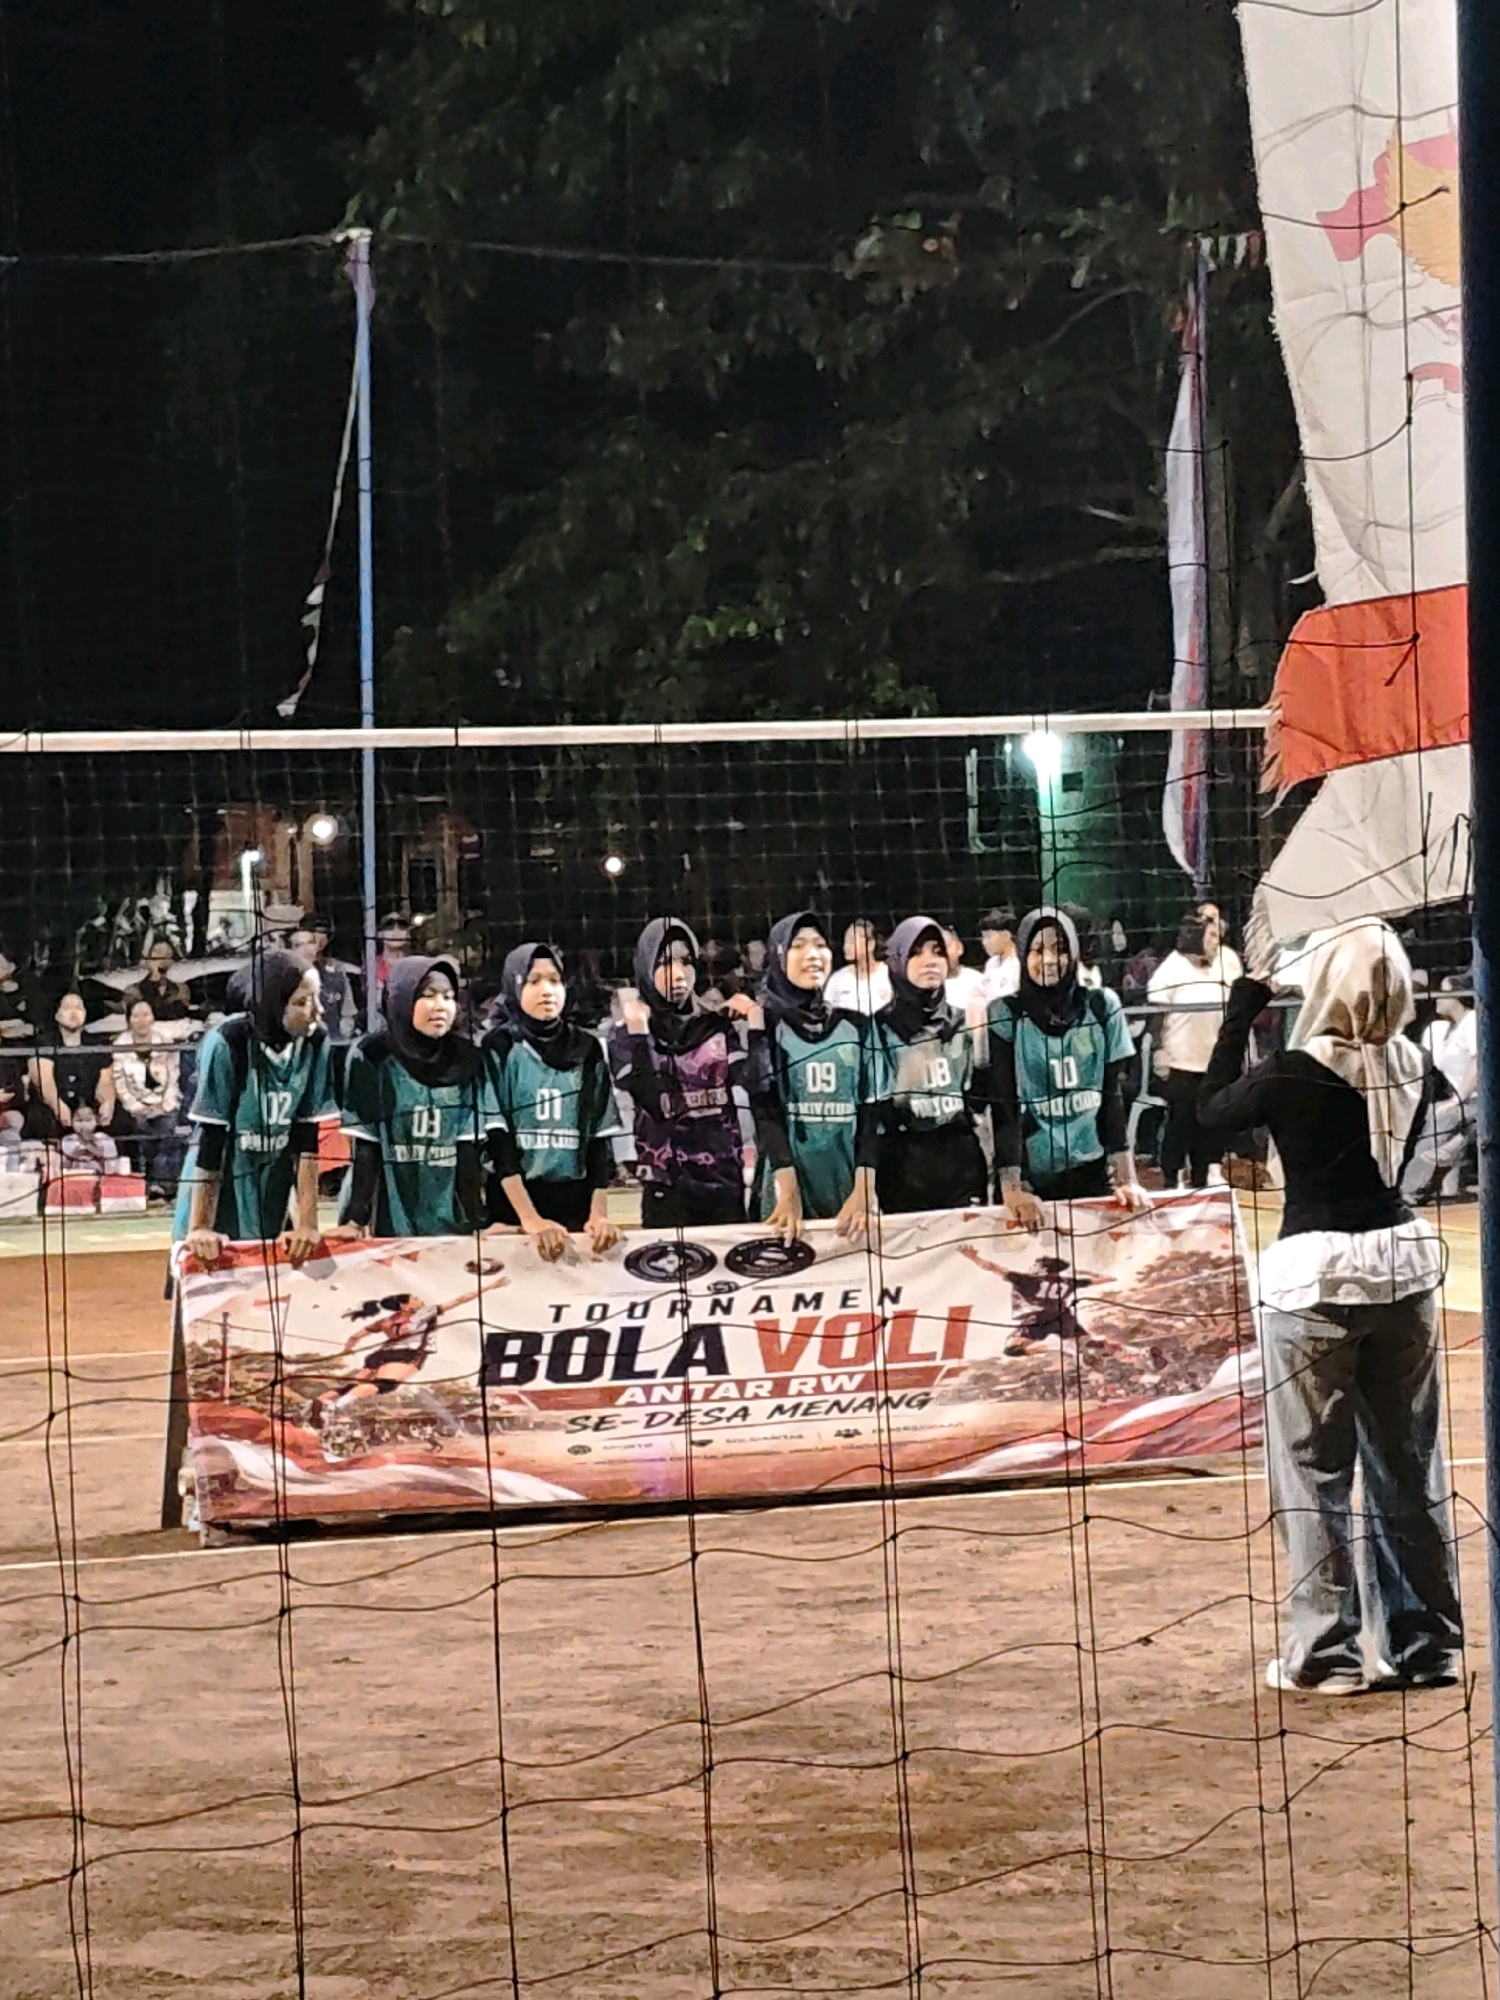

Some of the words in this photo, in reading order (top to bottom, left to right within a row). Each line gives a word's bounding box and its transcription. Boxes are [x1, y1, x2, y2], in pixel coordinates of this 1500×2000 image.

[805, 1062, 837, 1094] 09
[1049, 1056, 1079, 1090] 10
[262, 1091, 293, 1126] 02
[411, 1104, 442, 1138] 03
[536, 1087, 562, 1121] 01
[548, 1286, 903, 1324] TOURNAMEN
[1035, 1280, 1069, 1299] 10
[478, 1322, 731, 1387] BOLA
[753, 1304, 974, 1374] VOLI
[613, 1379, 774, 1406] ANTAR
[787, 1372, 866, 1396] RW
[565, 1405, 751, 1434] SE-DESA
[766, 1390, 935, 1420] MENANG
